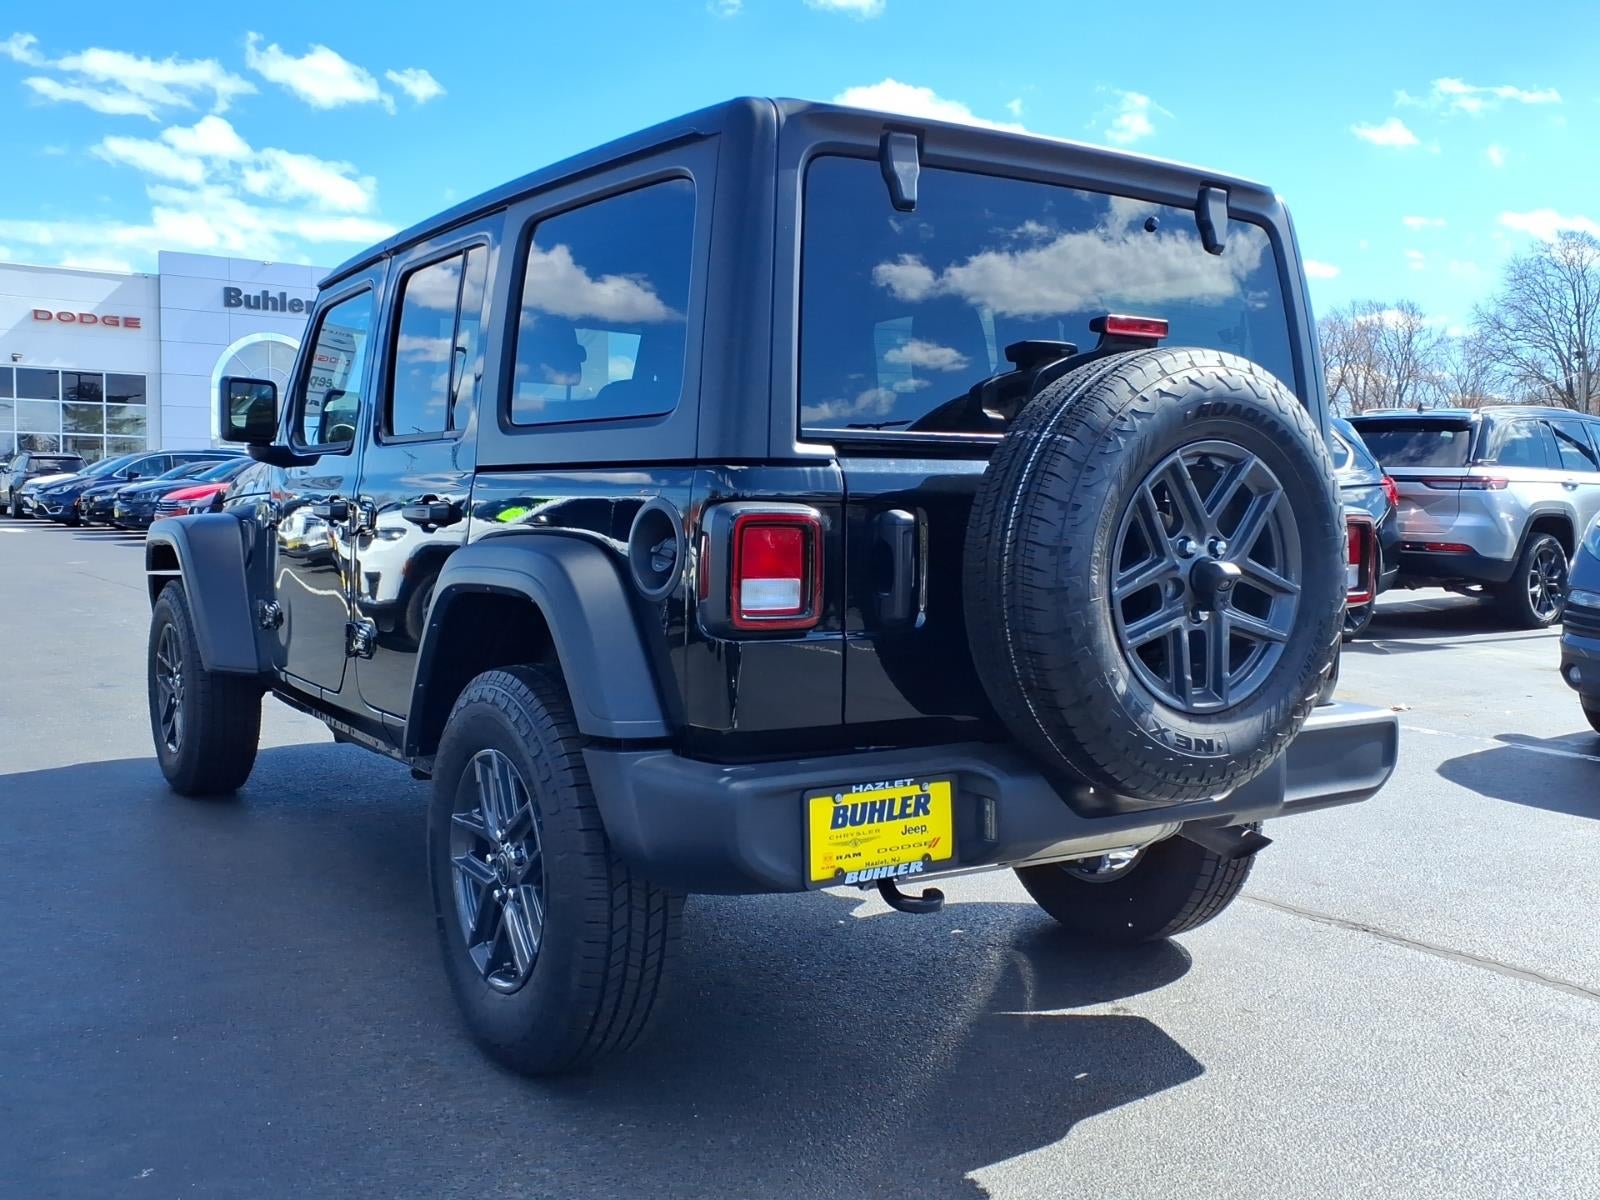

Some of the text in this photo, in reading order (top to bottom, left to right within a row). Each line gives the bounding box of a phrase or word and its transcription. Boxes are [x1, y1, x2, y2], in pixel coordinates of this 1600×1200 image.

[223, 286, 316, 315] Buhler
[32, 309, 141, 329] DODGE
[852, 778, 914, 793] HAZLET
[830, 793, 931, 830] BUHLER
[828, 828, 881, 841] CHRYSLER
[901, 824, 927, 836] Jeep
[877, 841, 930, 854] DODGE
[836, 852, 862, 860] RAM
[844, 861, 923, 885] BUHLER
